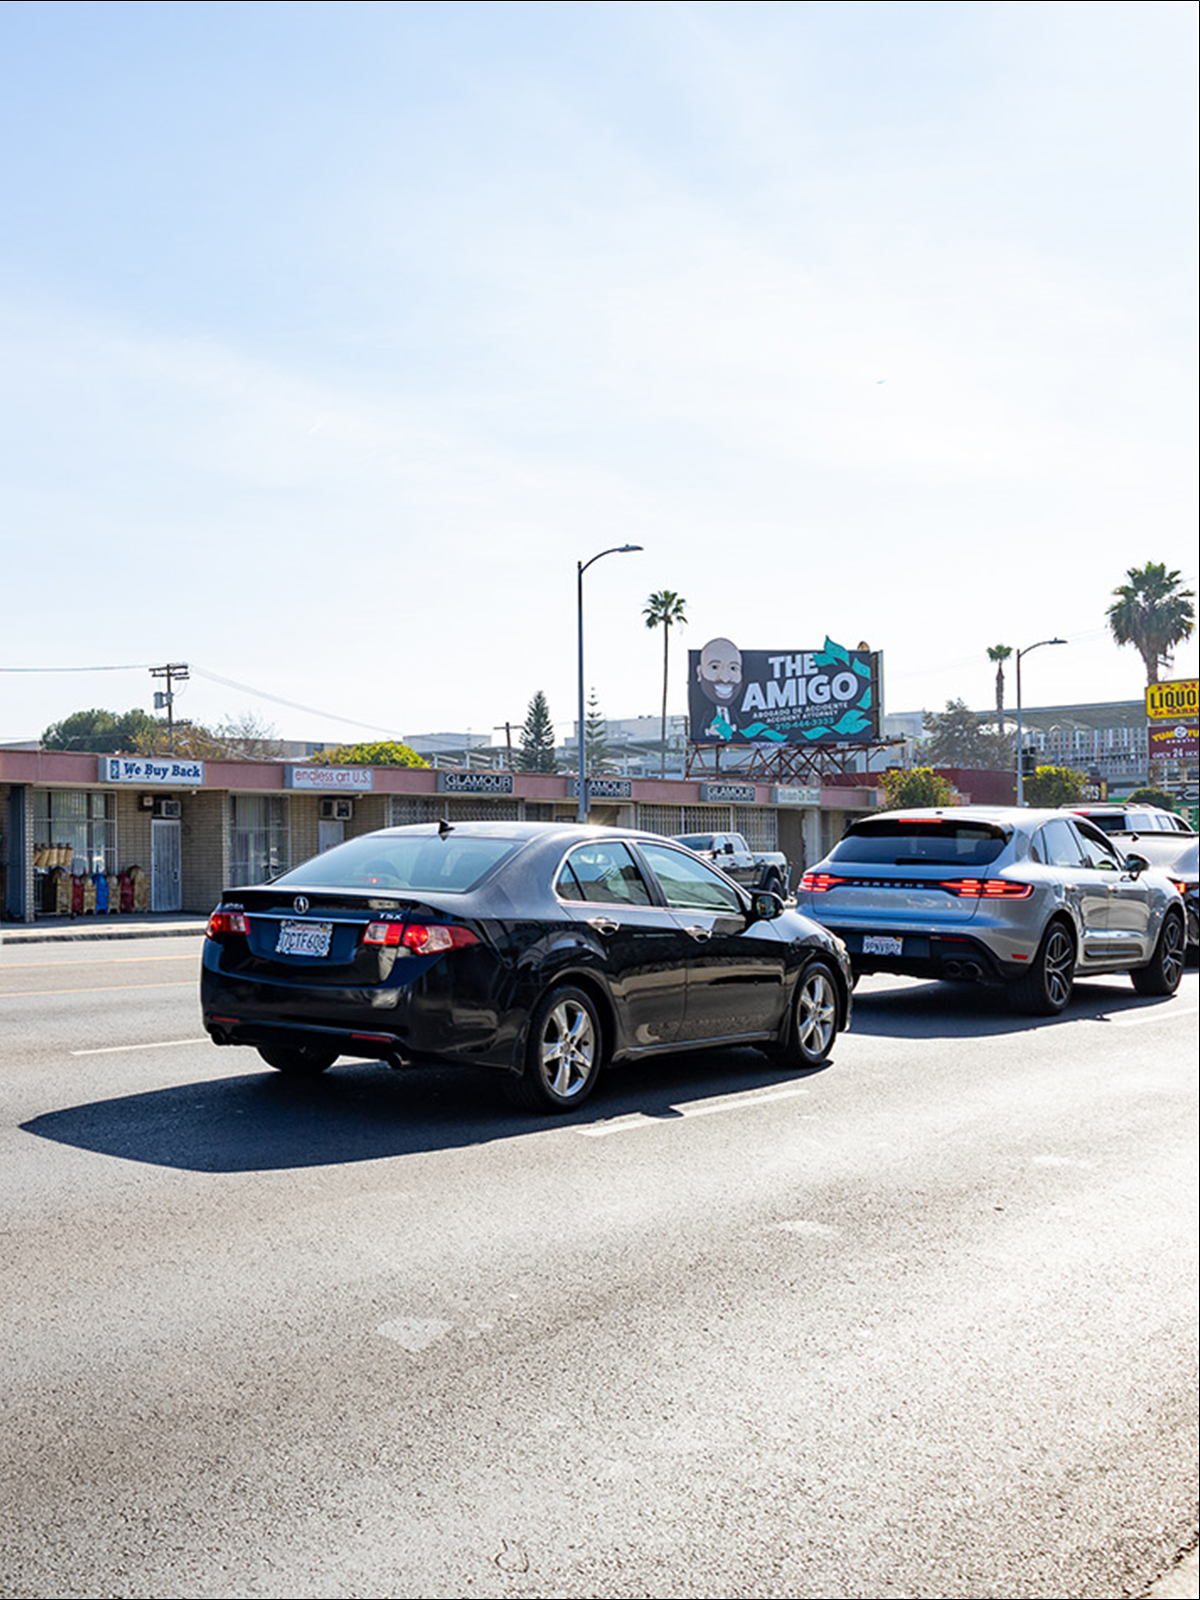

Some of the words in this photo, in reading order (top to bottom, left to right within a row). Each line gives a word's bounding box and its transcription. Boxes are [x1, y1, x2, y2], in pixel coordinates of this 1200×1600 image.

[768, 653, 819, 679] THE
[741, 671, 858, 712] AMIGO
[1151, 689, 1199, 709] LIQUO
[753, 708, 790, 719] ABOGADO
[805, 702, 848, 713] ACCIDENTE
[766, 713, 801, 723] ACCIDENT
[803, 710, 838, 719] ATTORNEY
[1167, 706, 1199, 714] MARK
[1152, 730, 1175, 742] YUM
[1172, 748, 1184, 758] 24
[124, 763, 141, 775] We
[144, 763, 168, 780] Buy
[171, 765, 201, 777] Back
[295, 769, 334, 782] endless
[335, 772, 350, 782] art
[446, 773, 511, 787] GLAMOUR
[574, 780, 630, 792] GAMOUR
[707, 786, 755, 797] GLAMOUR
[379, 912, 403, 920] TSX
